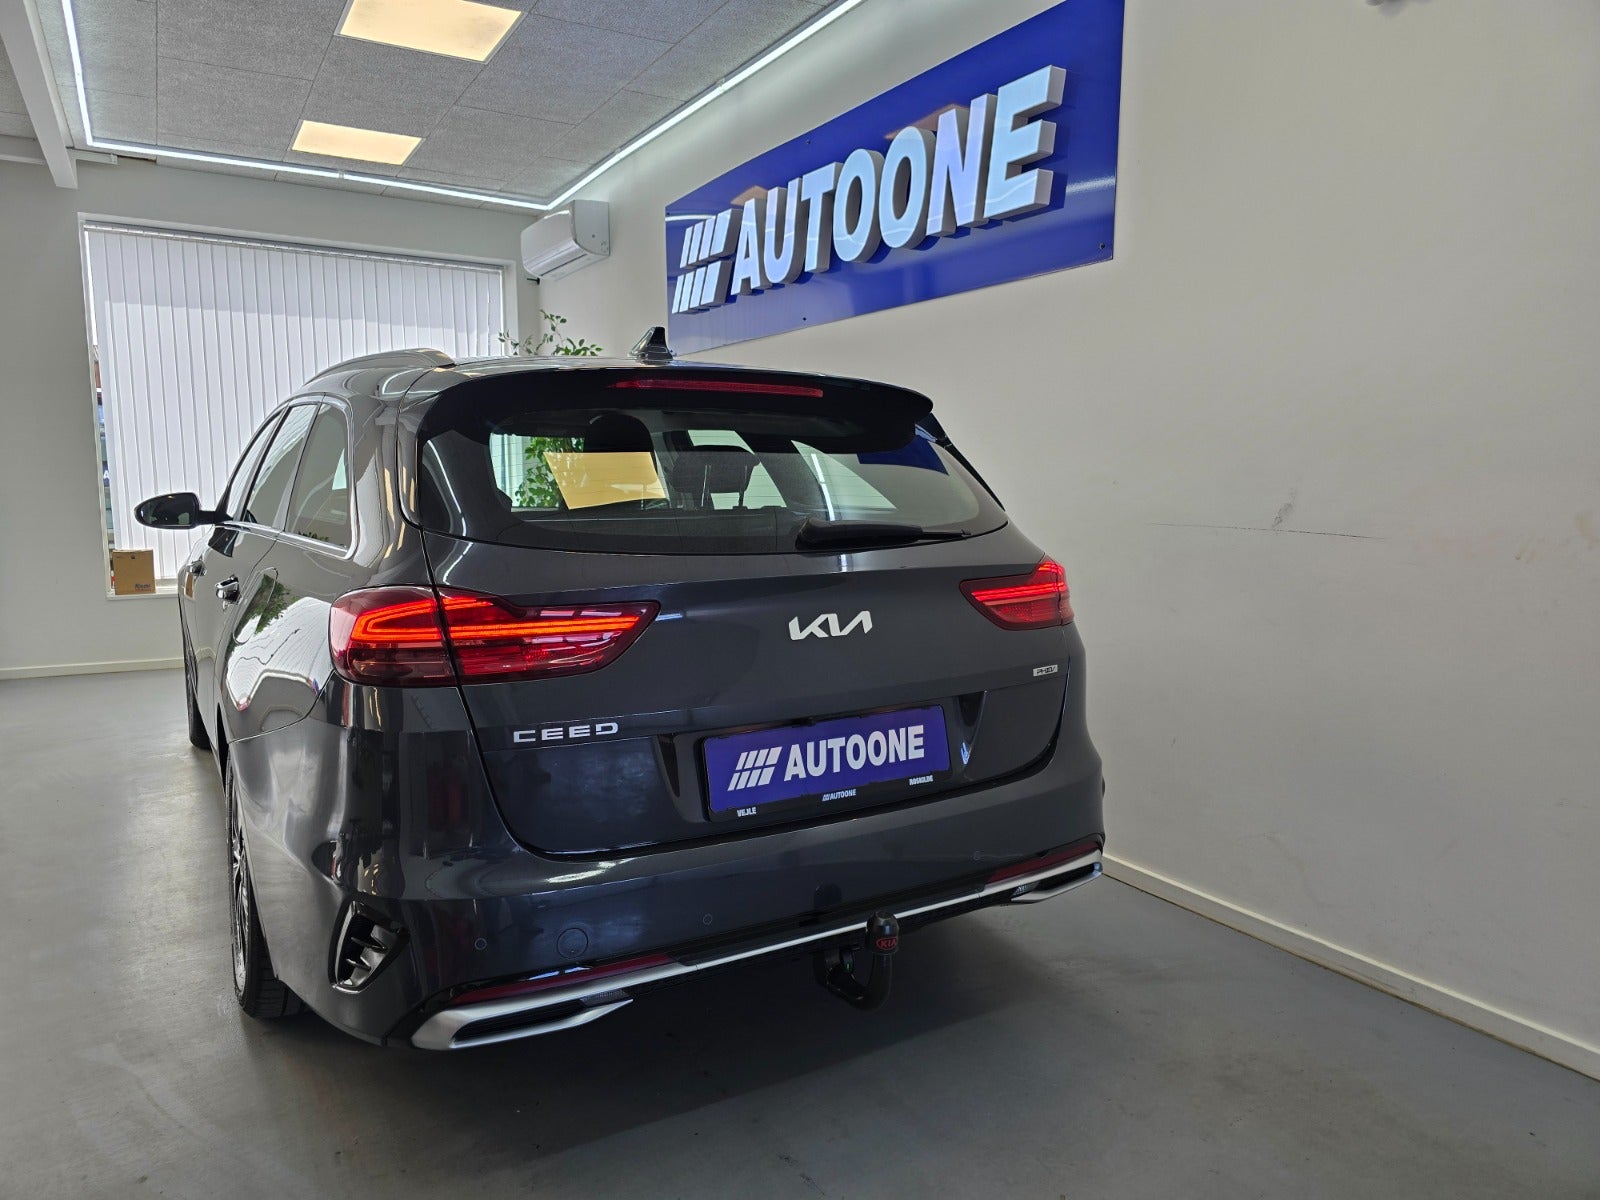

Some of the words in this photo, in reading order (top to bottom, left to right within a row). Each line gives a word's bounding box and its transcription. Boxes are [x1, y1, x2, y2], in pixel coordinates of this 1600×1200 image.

[731, 65, 1066, 296] AUTOONE
[788, 610, 873, 641] KIA
[513, 722, 619, 743] CEED
[784, 724, 925, 782] AUTOONE
[829, 788, 857, 801] AUTOONE
[736, 806, 757, 818] VEJLE
